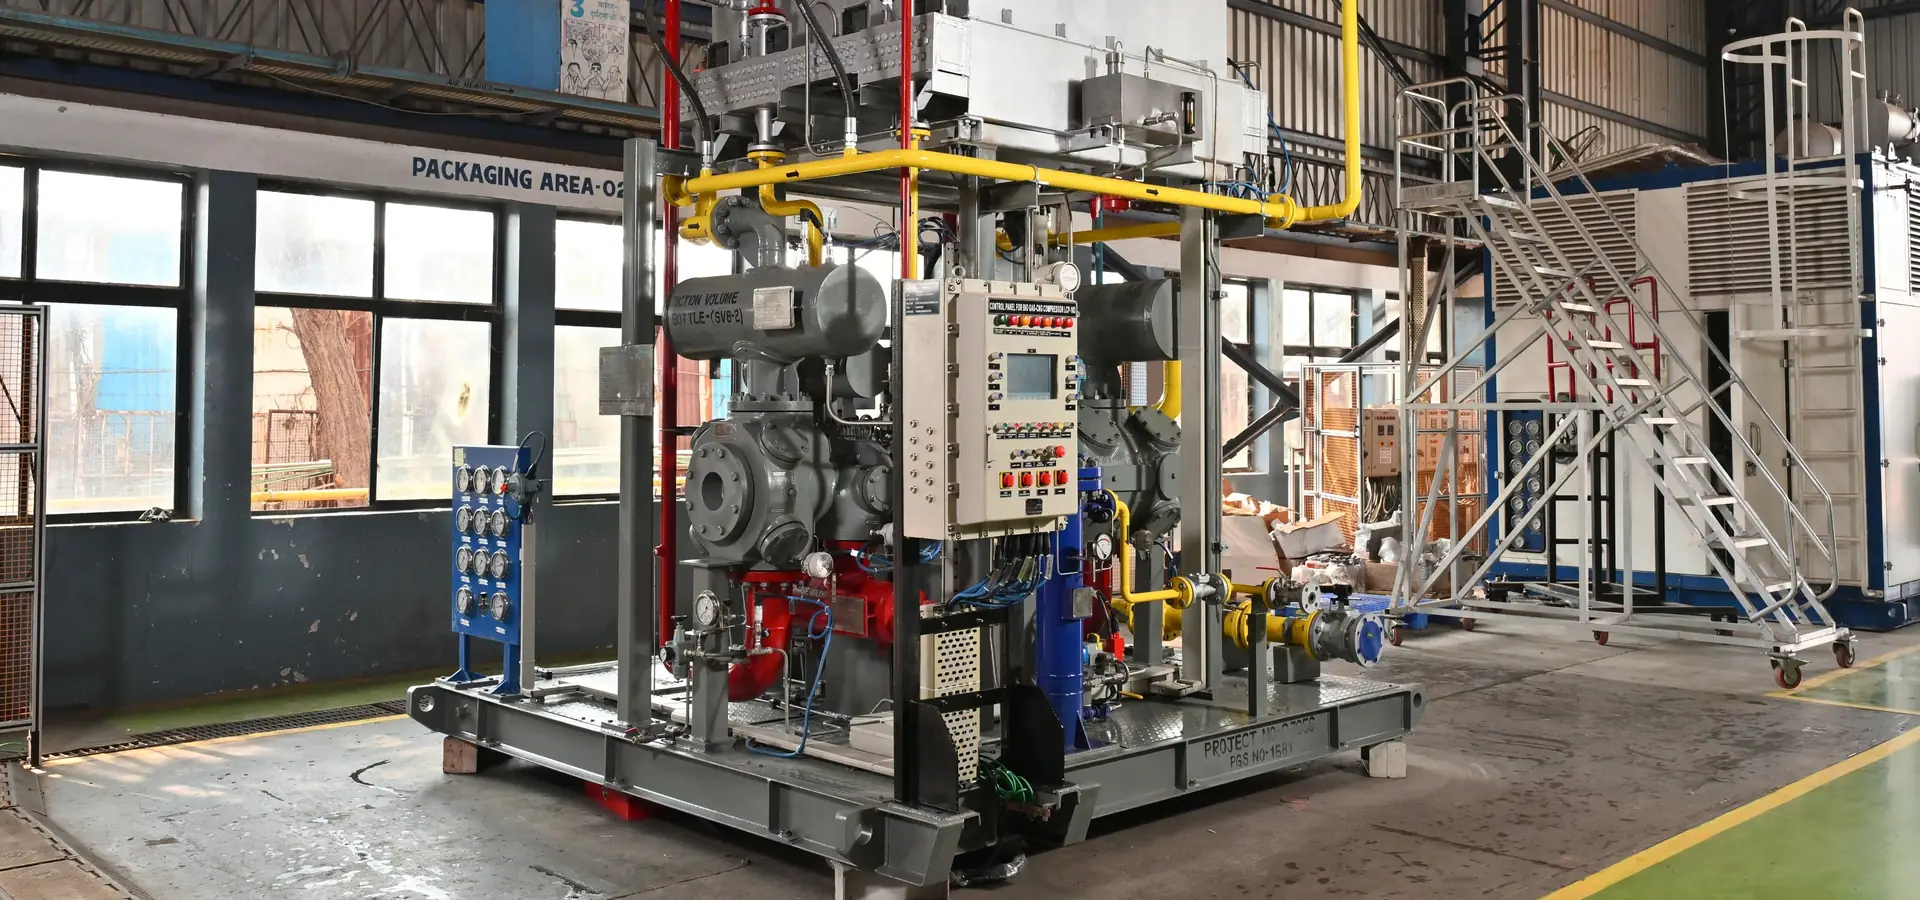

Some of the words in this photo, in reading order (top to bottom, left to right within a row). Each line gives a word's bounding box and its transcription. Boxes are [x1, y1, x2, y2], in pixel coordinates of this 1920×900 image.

[570, 0, 585, 17] 3
[447, 79, 460, 87] AIR
[412, 157, 532, 190] PACKAGING
[539, 172, 624, 199] AREA-02
[705, 291, 739, 306] VOLUME
[989, 302, 1005, 311] CONTROL
[1005, 303, 1016, 311] PANEL
[1043, 305, 1064, 313] COMPRESSOR
[1204, 730, 1257, 758] PROJECT
[1230, 751, 1249, 769] PGS
